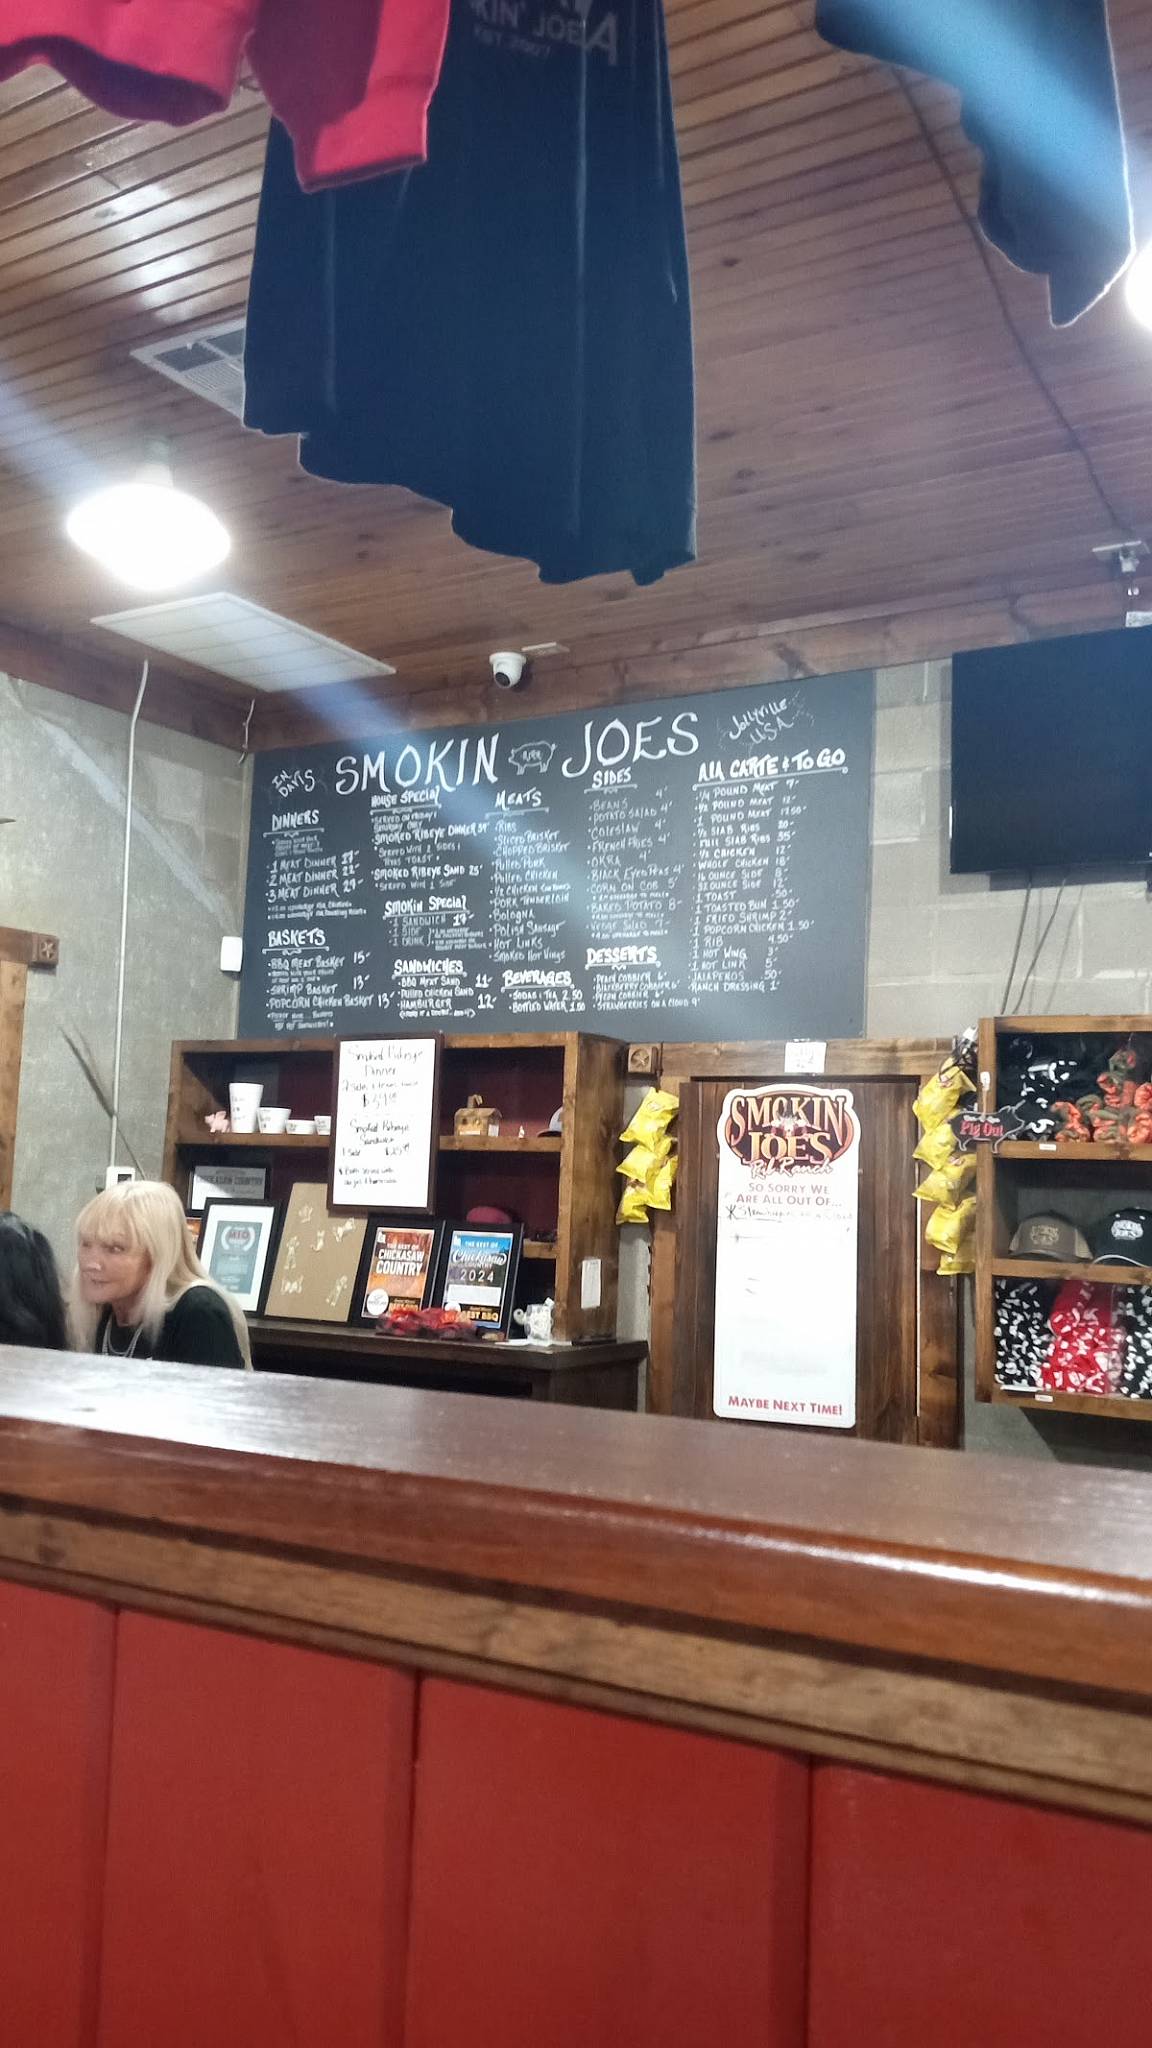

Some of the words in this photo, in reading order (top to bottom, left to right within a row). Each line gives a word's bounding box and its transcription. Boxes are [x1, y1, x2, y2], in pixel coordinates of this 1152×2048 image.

[750, 716, 794, 744] USA
[335, 731, 500, 796] SMOKIN
[562, 712, 699, 778] JOES
[729, 752, 779, 778] CARTE
[816, 747, 846, 768] GO
[271, 769, 292, 790] IN
[278, 769, 316, 798] DAVIS
[591, 766, 632, 789] SIDES
[713, 784, 748, 799] POUND
[752, 780, 779, 796] MEAT
[370, 794, 399, 809] HOUSE
[495, 786, 542, 811] MEATS
[592, 797, 628, 812] BEANS
[712, 799, 745, 811] POUND
[750, 795, 775, 807] MEAT
[271, 808, 320, 832] DINNERS
[593, 809, 626, 826] POTATO
[711, 811, 744, 823] POUND
[747, 807, 773, 819] MEAT
[497, 819, 517, 833] RIBS
[374, 829, 412, 846] SMOKED
[412, 827, 447, 845] RIBEYE
[447, 822, 478, 837] DINNER
[498, 834, 525, 846] SLICED
[524, 829, 560, 844] BRISKET
[495, 845, 534, 858] CHOPPED
[534, 841, 571, 855] BRISKET
[592, 836, 626, 854] FRENCH
[713, 846, 756, 859] CHICKEN
[279, 859, 302, 873] MEAT
[304, 855, 338, 869] DINNER
[521, 855, 546, 869] PORK
[591, 854, 622, 869] OKRA
[698, 858, 729, 870] WHOLE
[735, 855, 770, 868] CHICKEN
[268, 874, 278, 887] 2
[279, 871, 304, 887] MEAT
[304, 868, 339, 884] DINNER
[374, 866, 410, 882] SMOKED
[411, 865, 442, 881] RIBEYE
[443, 864, 466, 878] SAND
[525, 869, 559, 883] CHICKEN
[708, 869, 737, 880] OUNCE
[741, 867, 764, 879] SIDE
[590, 881, 617, 895] CORN
[621, 882, 634, 892] ON
[639, 880, 659, 891] COB
[709, 879, 738, 890] OUNCE
[742, 878, 762, 890] SIDE
[269, 888, 277, 902] 3
[278, 886, 302, 902] MEAT
[303, 882, 340, 898] DINNER
[704, 889, 737, 902] TOAST
[494, 897, 519, 909] PORK
[591, 901, 622, 914] BAKED
[624, 900, 663, 912] POTATO
[704, 901, 747, 913] TOASTED
[748, 898, 767, 911] BUN
[402, 914, 447, 928] SANDWICH
[706, 913, 736, 925] FRIED
[739, 910, 777, 924] SHRIMP
[402, 927, 421, 937] SIDE
[493, 923, 525, 938] POLISH
[704, 923, 747, 935] POPCORN
[748, 920, 785, 934] CHICKEN
[267, 926, 326, 948] BASKETS
[493, 937, 512, 950] HOT
[516, 936, 544, 950] LINKS
[703, 935, 724, 948] RIB
[586, 944, 658, 964] DESSERTS
[702, 947, 720, 959] HOT
[723, 945, 748, 960] WING
[270, 957, 290, 971] BBQ
[290, 957, 313, 971] MEAT
[315, 954, 346, 970] BASKET
[394, 957, 464, 976] SANDWICHES
[701, 960, 719, 971] HOT
[722, 959, 746, 971] LINK
[419, 977, 439, 988] MEAT
[440, 976, 461, 987] SAND
[502, 968, 573, 987] BEVERAGES
[269, 982, 304, 999] SHRIMP
[304, 982, 338, 996] BASKET
[691, 981, 720, 994] RANCH
[723, 980, 766, 993] DRESSING
[269, 995, 311, 1010] POPCORN
[343, 993, 375, 1009] BASKET
[544, 990, 557, 1001] TEA
[400, 998, 453, 1010] HAMBURGER
[512, 1001, 541, 1014] BOTTLED
[543, 1001, 568, 1012] WATER
[596, 1000, 648, 1012] STRAWBERRIES
[730, 1094, 846, 1147] SMOKIN
[960, 1119, 982, 1138] Pig
[983, 1121, 1004, 1138] Out
[742, 1130, 834, 1166] JOES
[750, 1159, 777, 1180] Rib
[776, 1156, 834, 1177] Ranch
[378, 1248, 425, 1263] CHICKASAW
[452, 1249, 508, 1266] Chickasaw
[376, 1260, 423, 1276] COUNTRY
[460, 1269, 495, 1283] 2024
[481, 1311, 499, 1322] BBQ
